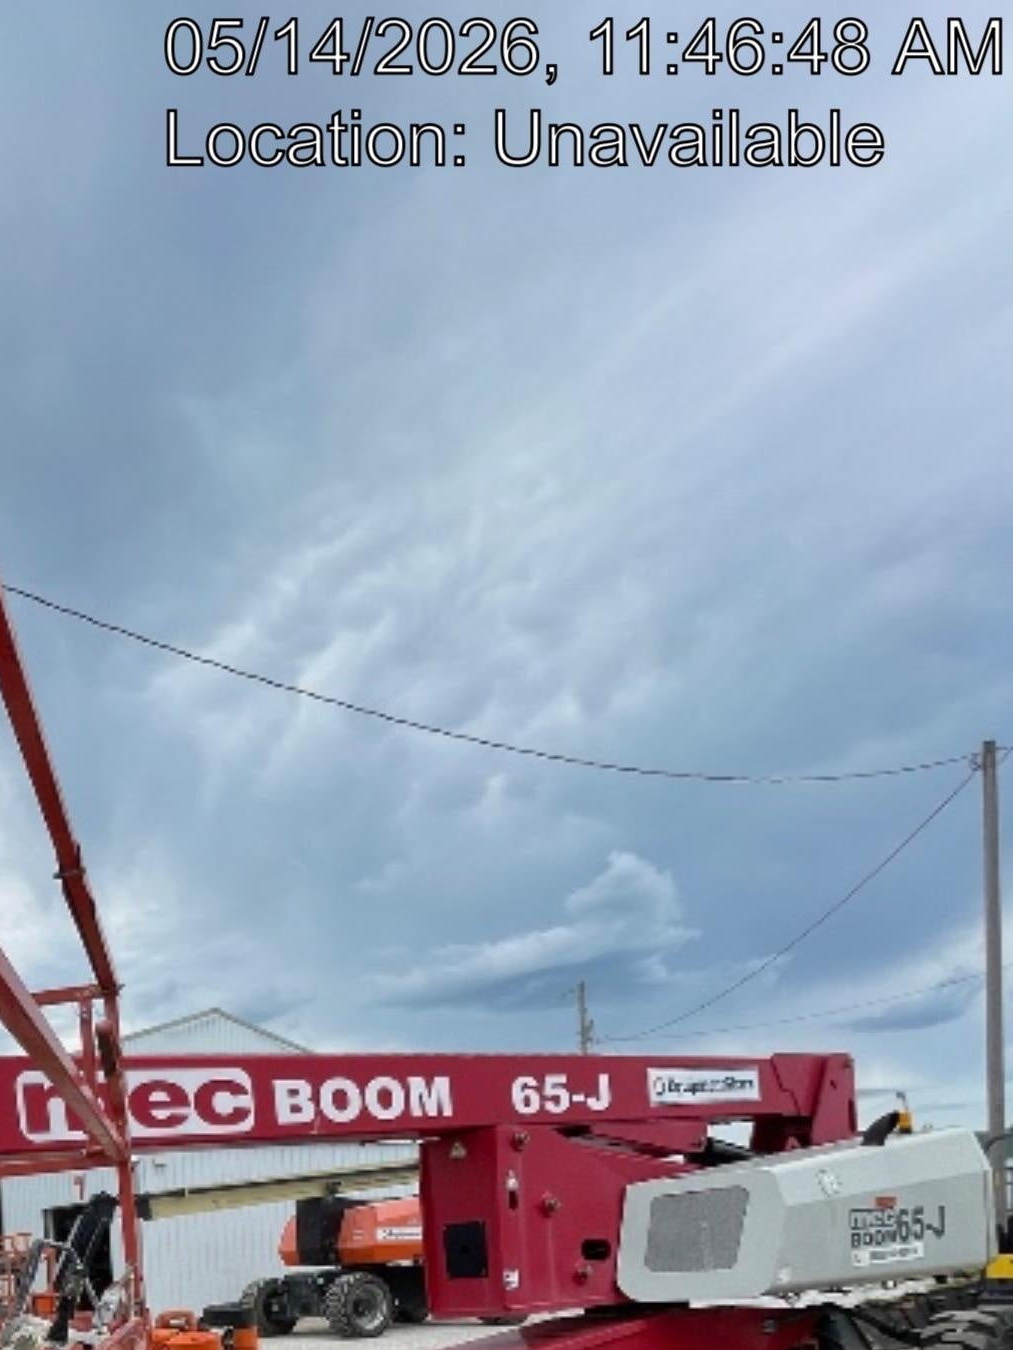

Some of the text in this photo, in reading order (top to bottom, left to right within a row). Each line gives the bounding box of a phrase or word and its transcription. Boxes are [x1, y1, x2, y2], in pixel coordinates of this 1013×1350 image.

[272, 1076, 453, 1125] BOOM
[511, 1073, 612, 1115] 65-J
[896, 1205, 946, 1242] 65-J
